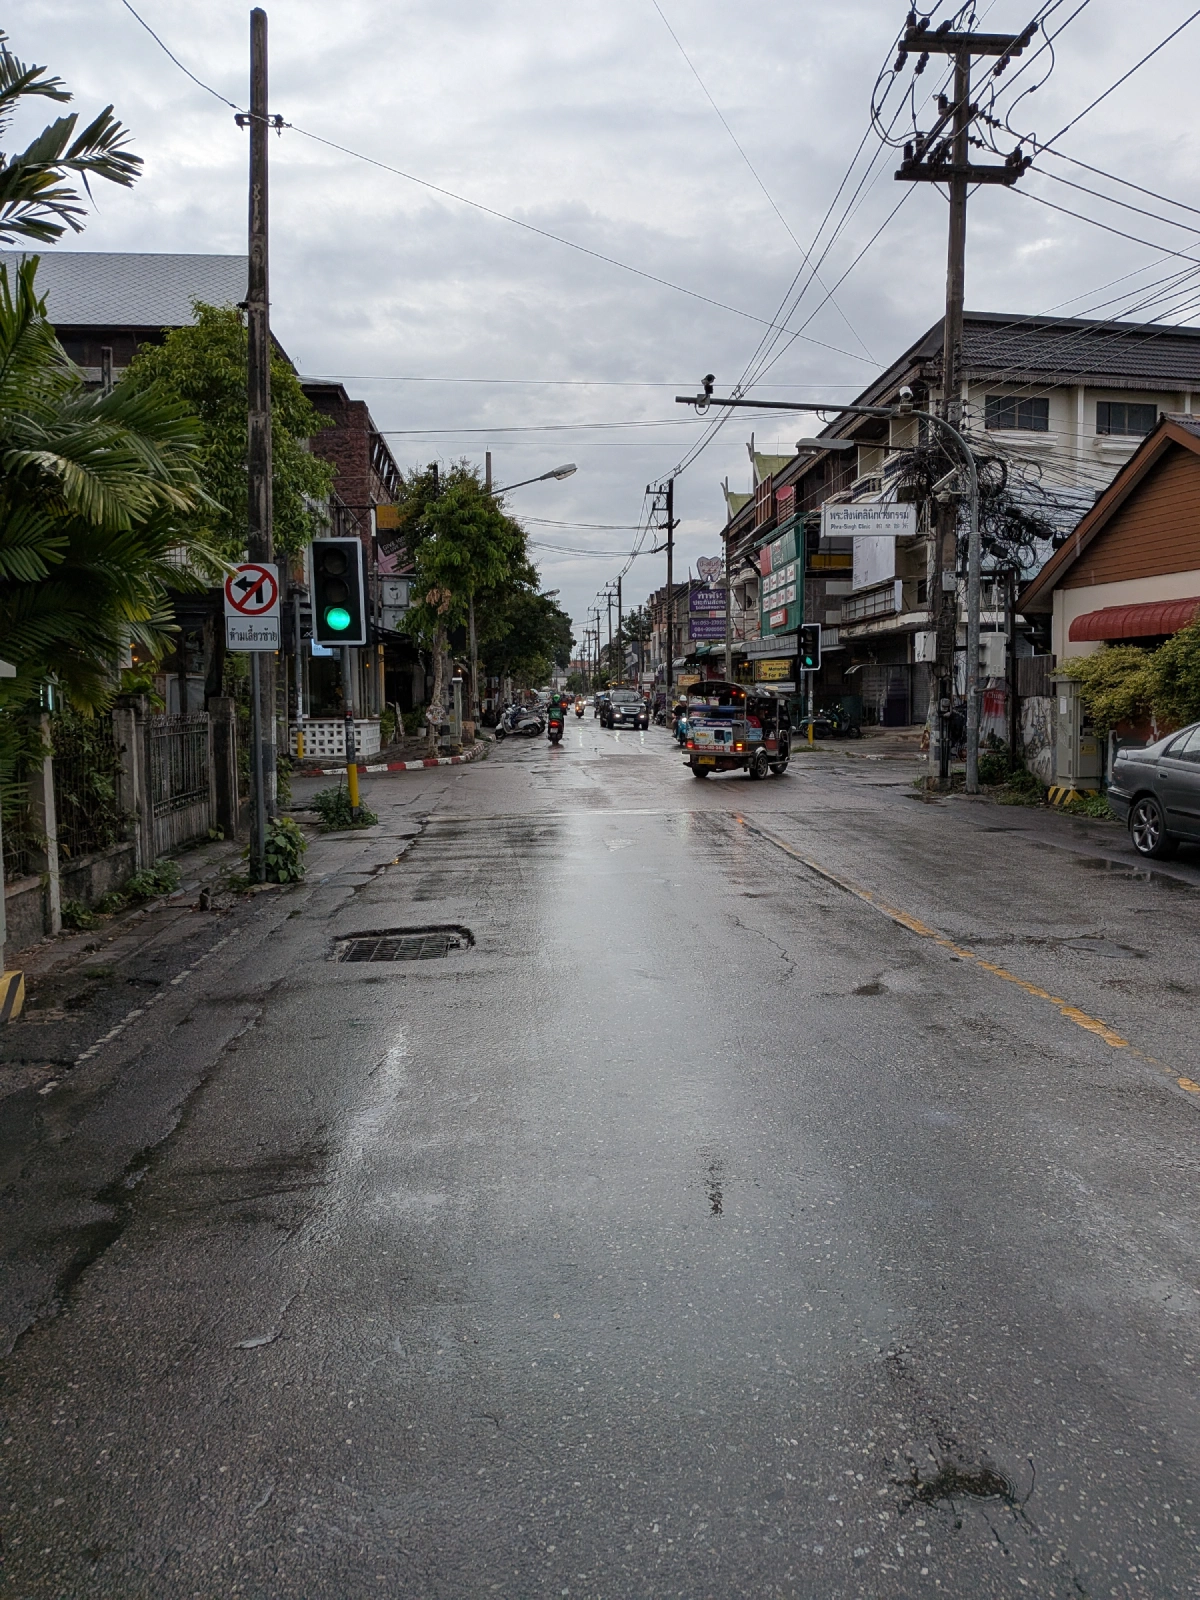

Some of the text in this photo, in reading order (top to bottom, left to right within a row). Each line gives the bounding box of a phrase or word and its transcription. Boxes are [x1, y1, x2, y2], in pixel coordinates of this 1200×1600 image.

[230, 625, 278, 641] ห้ามเลี้ยวซ้าย
